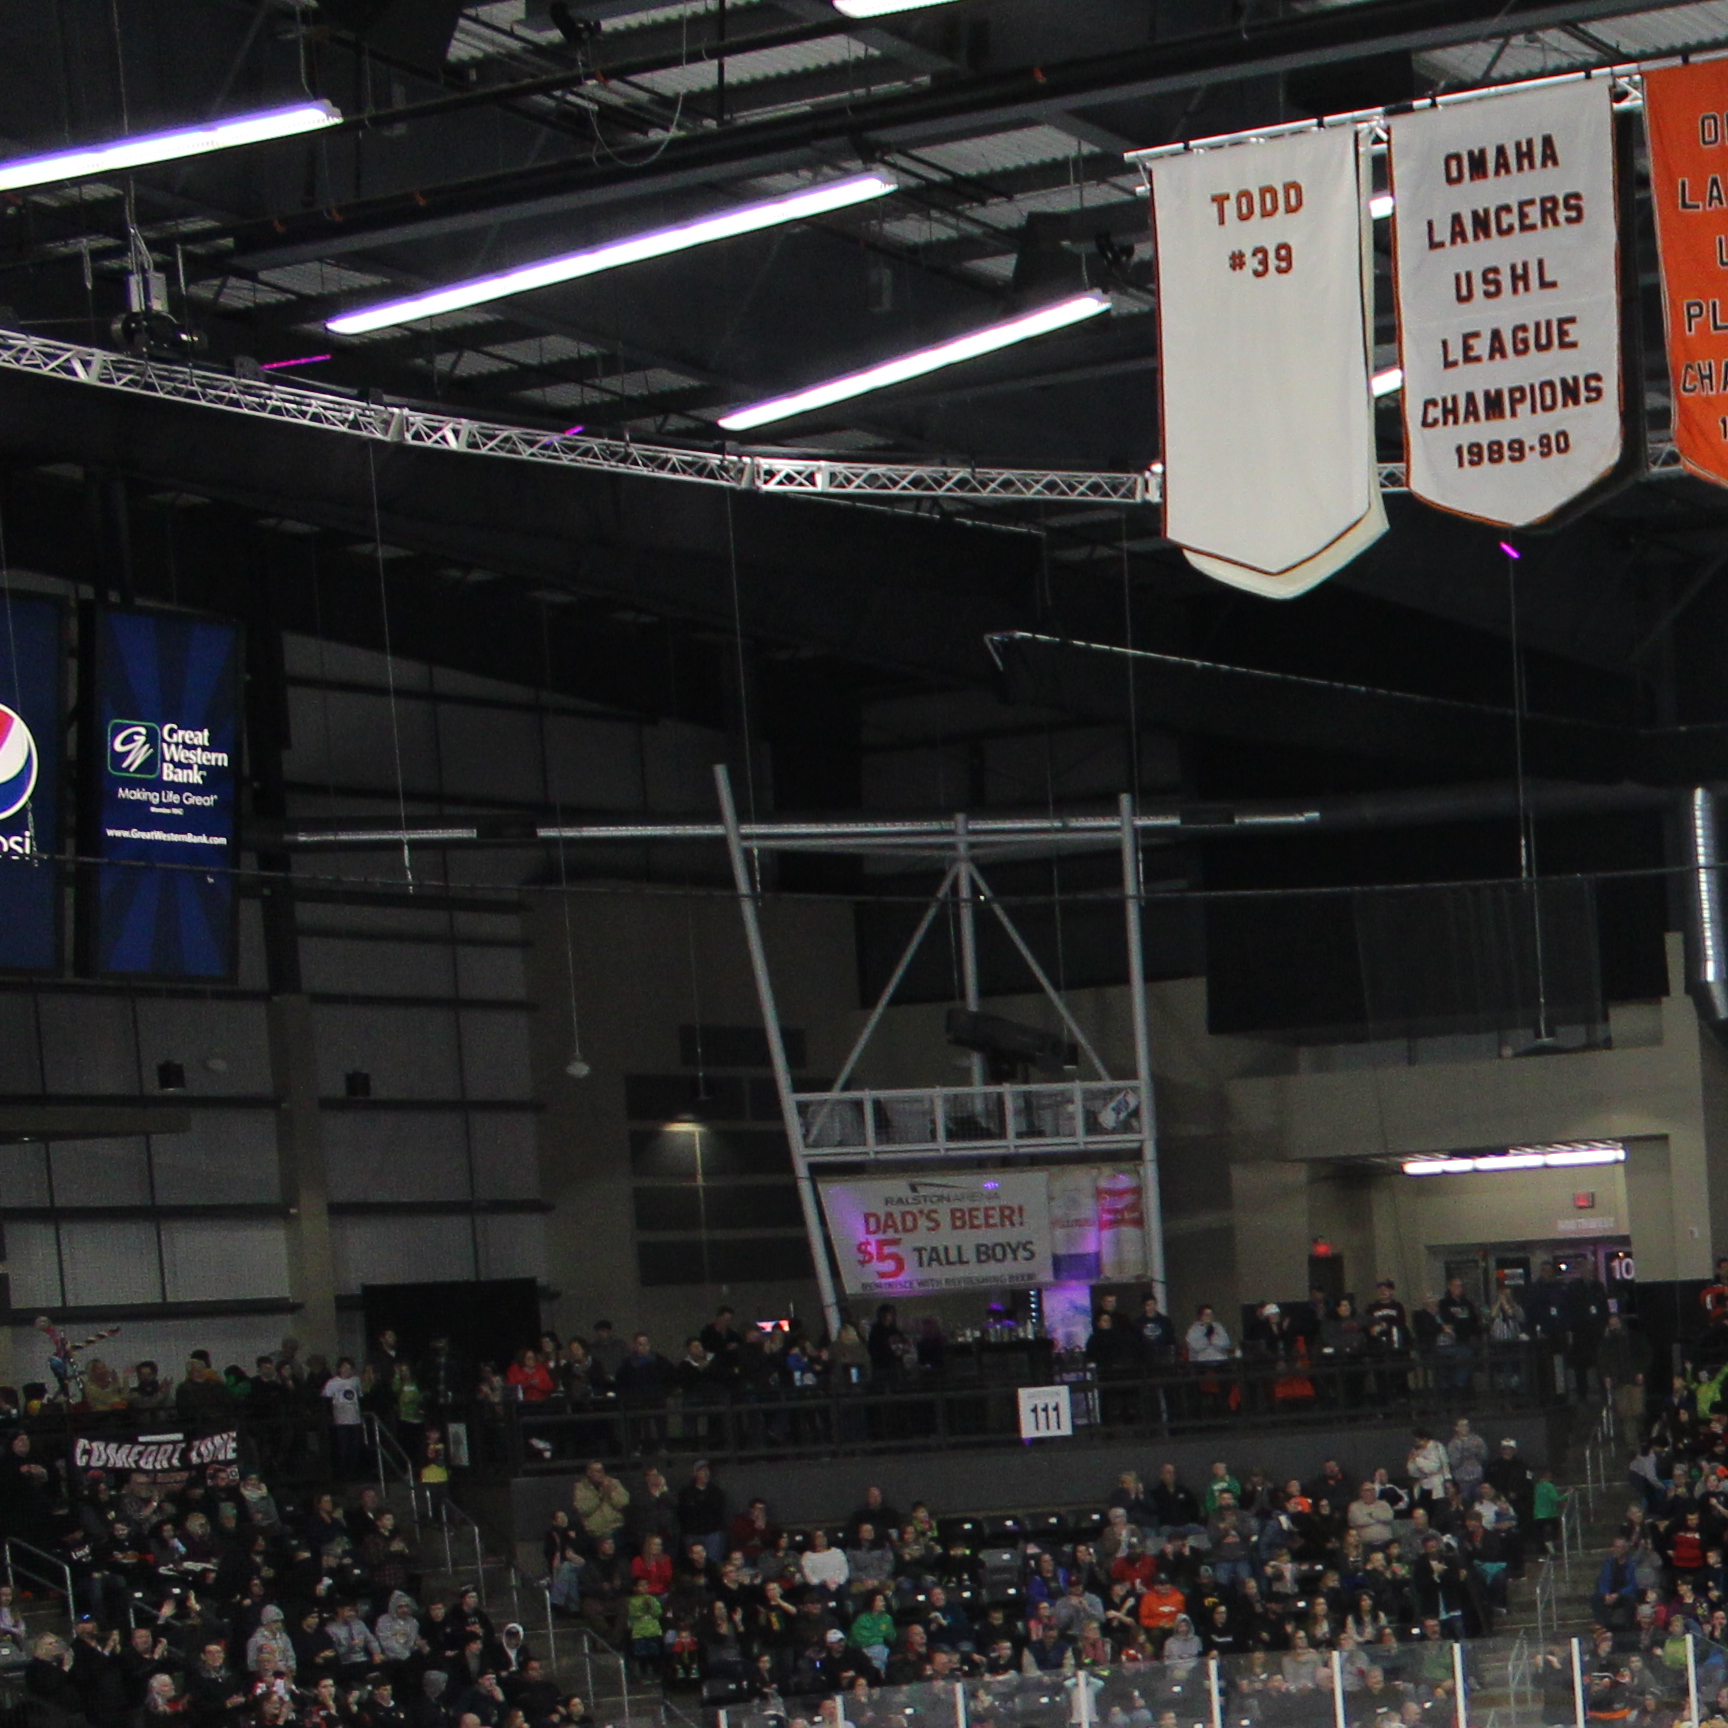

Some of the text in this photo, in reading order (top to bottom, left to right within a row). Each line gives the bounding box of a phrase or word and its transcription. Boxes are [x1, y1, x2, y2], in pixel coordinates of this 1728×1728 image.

[1443, 134, 1561, 186] OMAHA
[1211, 181, 1304, 225] TODD
[1426, 191, 1585, 251] LANCERS
[1228, 243, 1293, 279] #39
[1453, 259, 1559, 305] USHL
[1440, 316, 1580, 370] LEAGUE
[1421, 373, 1605, 430] CHAMPIONS
[1454, 430, 1571, 470] 1989-90
[162, 723, 210, 746] Great
[162, 743, 229, 767] Western
[162, 763, 204, 784] Bank
[118, 787, 216, 806] Making Life Great
[106, 828, 228, 845] www.GreatWesternBank.com
[864, 1210, 941, 1235] DAD'S
[951, 1205, 1025, 1231] BEER!
[857, 1238, 1036, 1279] $5 TALL BOYS
[1030, 1402, 1061, 1431] 111
[76, 1431, 238, 1470] COMFORT ZONE
